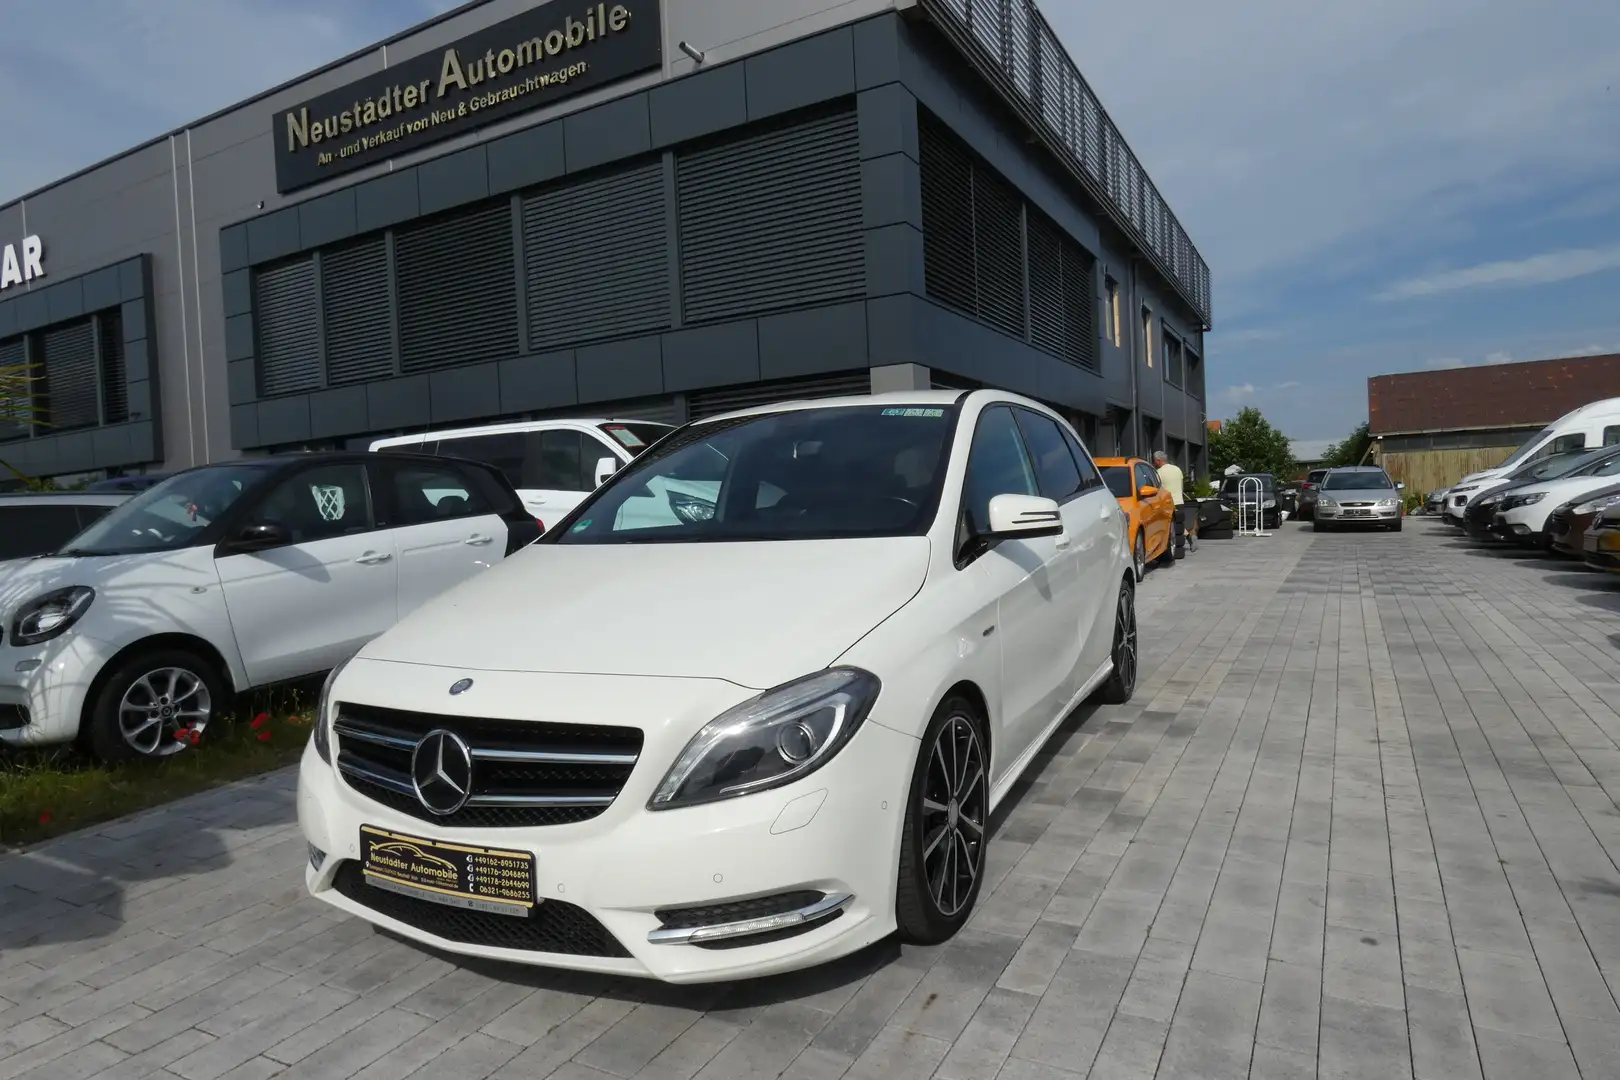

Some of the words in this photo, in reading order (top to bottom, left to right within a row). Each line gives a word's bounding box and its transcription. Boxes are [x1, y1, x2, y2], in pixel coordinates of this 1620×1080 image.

[286, 79, 430, 152] Neustädter
[437, 2, 632, 98] Automobile
[317, 150, 333, 166] An
[340, 139, 360, 159] und
[362, 123, 404, 151] Verkauf
[407, 116, 429, 134] von
[431, 108, 456, 127] Neu
[458, 101, 468, 117] &
[470, 61, 587, 112] Gebrauchtwagen
[410, 863, 459, 880] Automobile
